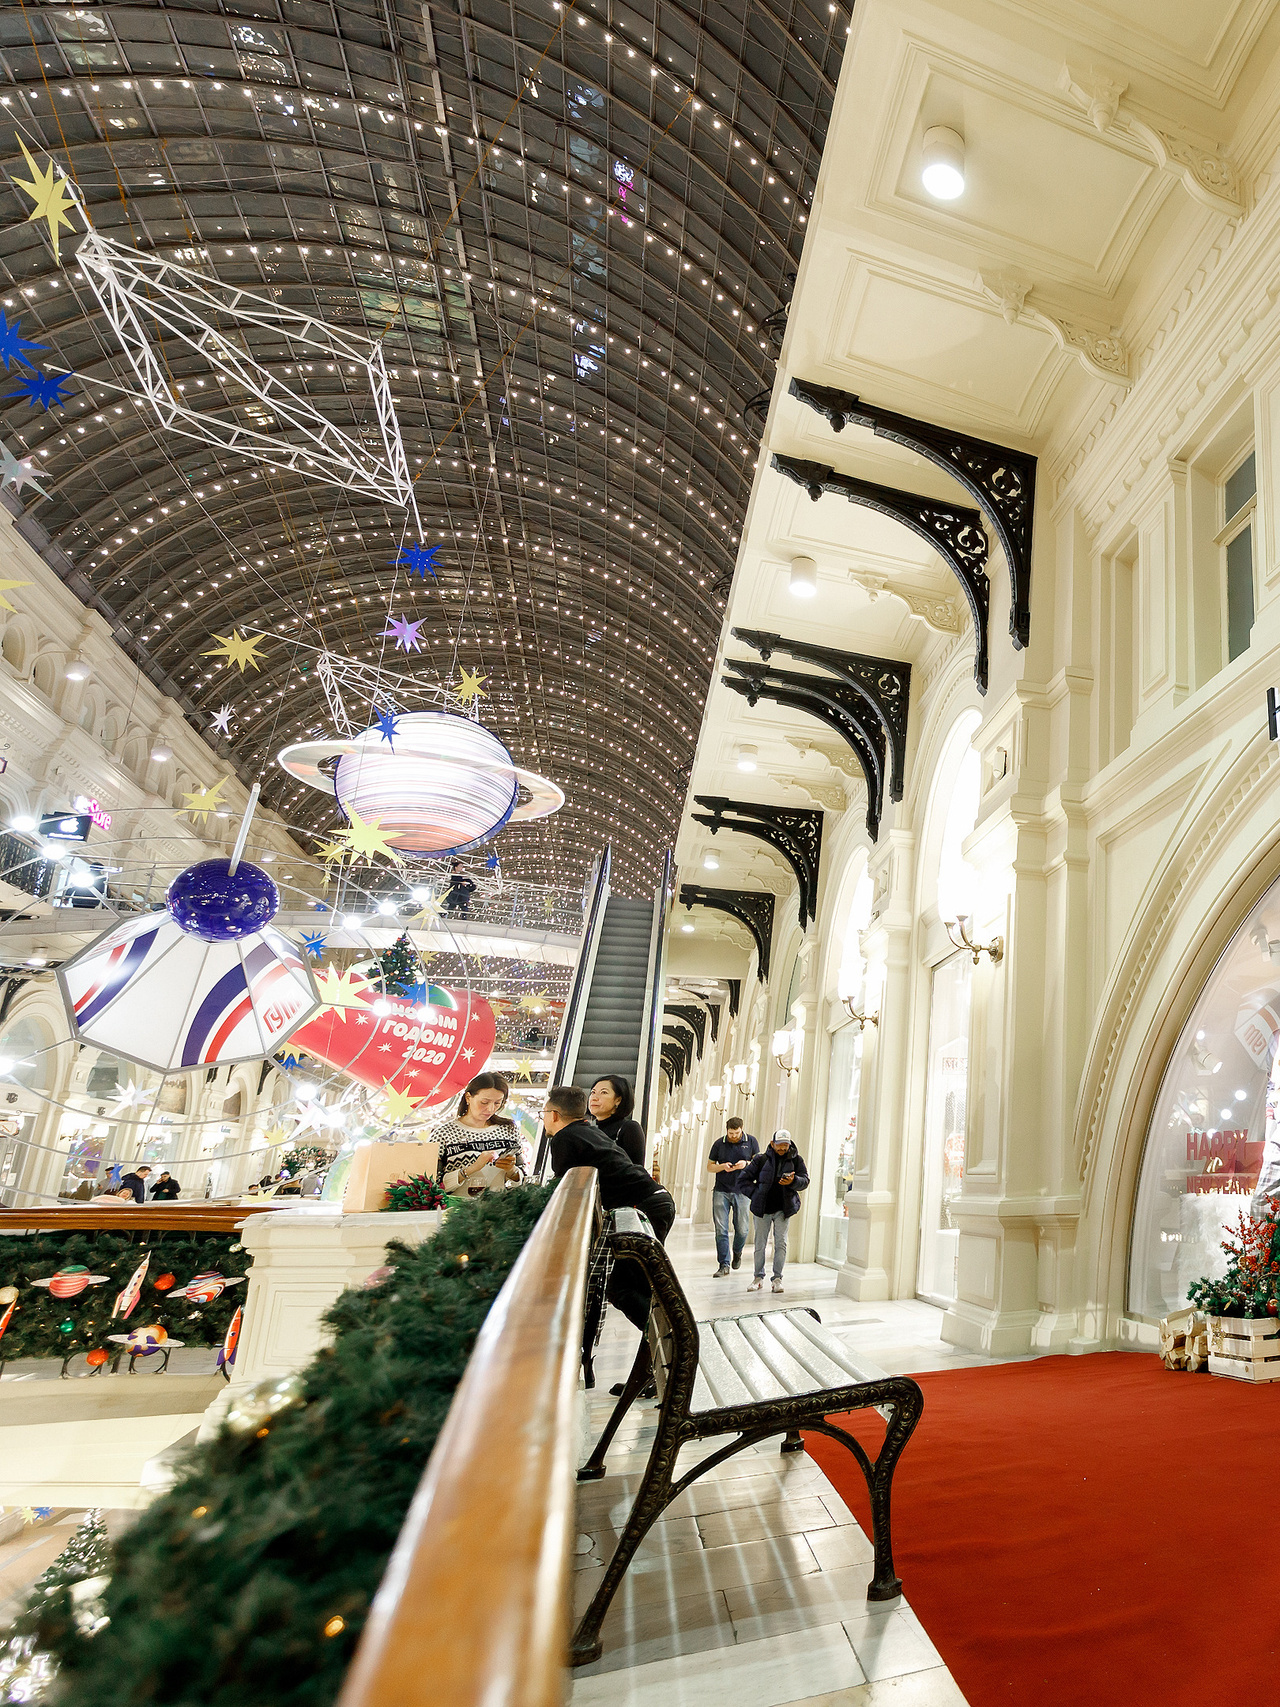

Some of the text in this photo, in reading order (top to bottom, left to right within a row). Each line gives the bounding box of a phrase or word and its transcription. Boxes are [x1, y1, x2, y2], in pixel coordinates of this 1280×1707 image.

[391, 1002, 457, 1030] НОЫМ
[382, 1020, 455, 1049] ГОДОМ!
[402, 1045, 446, 1065] 2020
[1186, 1129, 1248, 1162] HAPPY
